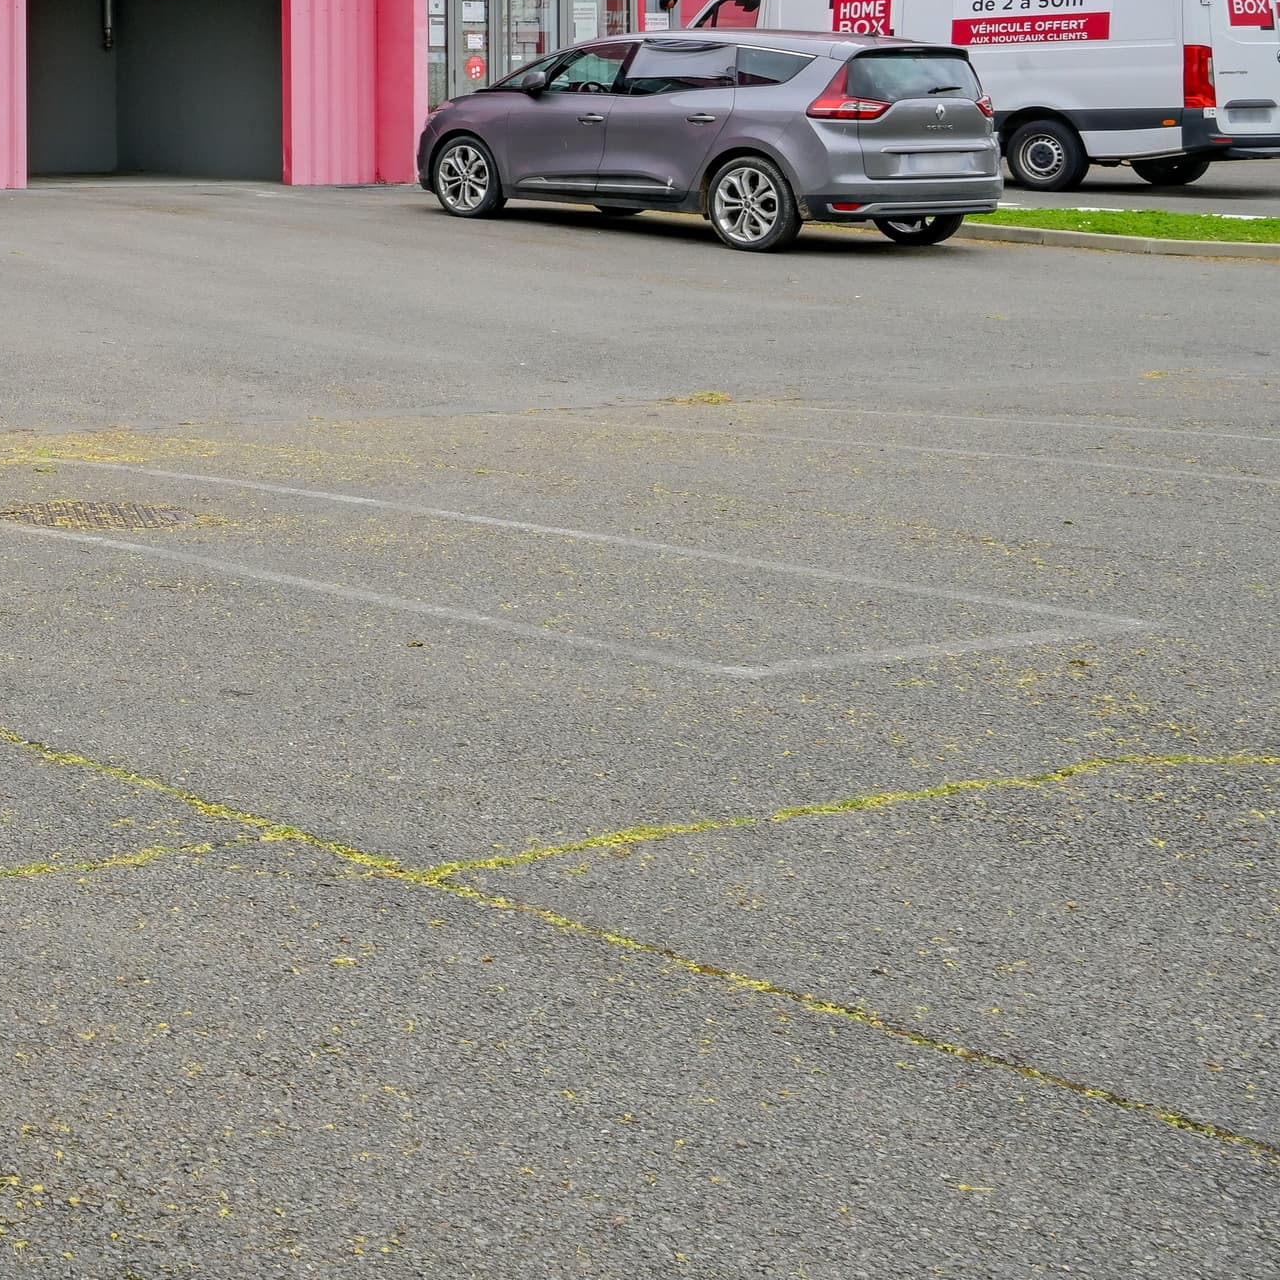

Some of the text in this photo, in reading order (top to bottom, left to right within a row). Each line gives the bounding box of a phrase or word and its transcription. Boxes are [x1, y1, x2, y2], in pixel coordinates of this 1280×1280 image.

[839, 0, 887, 19] HOME
[1232, 0, 1268, 14] BOX
[839, 18, 886, 35] BOX
[970, 21, 1031, 34] VÉHICULE
[970, 32, 1088, 44] AUX NOUVEAUX CLIENTS
